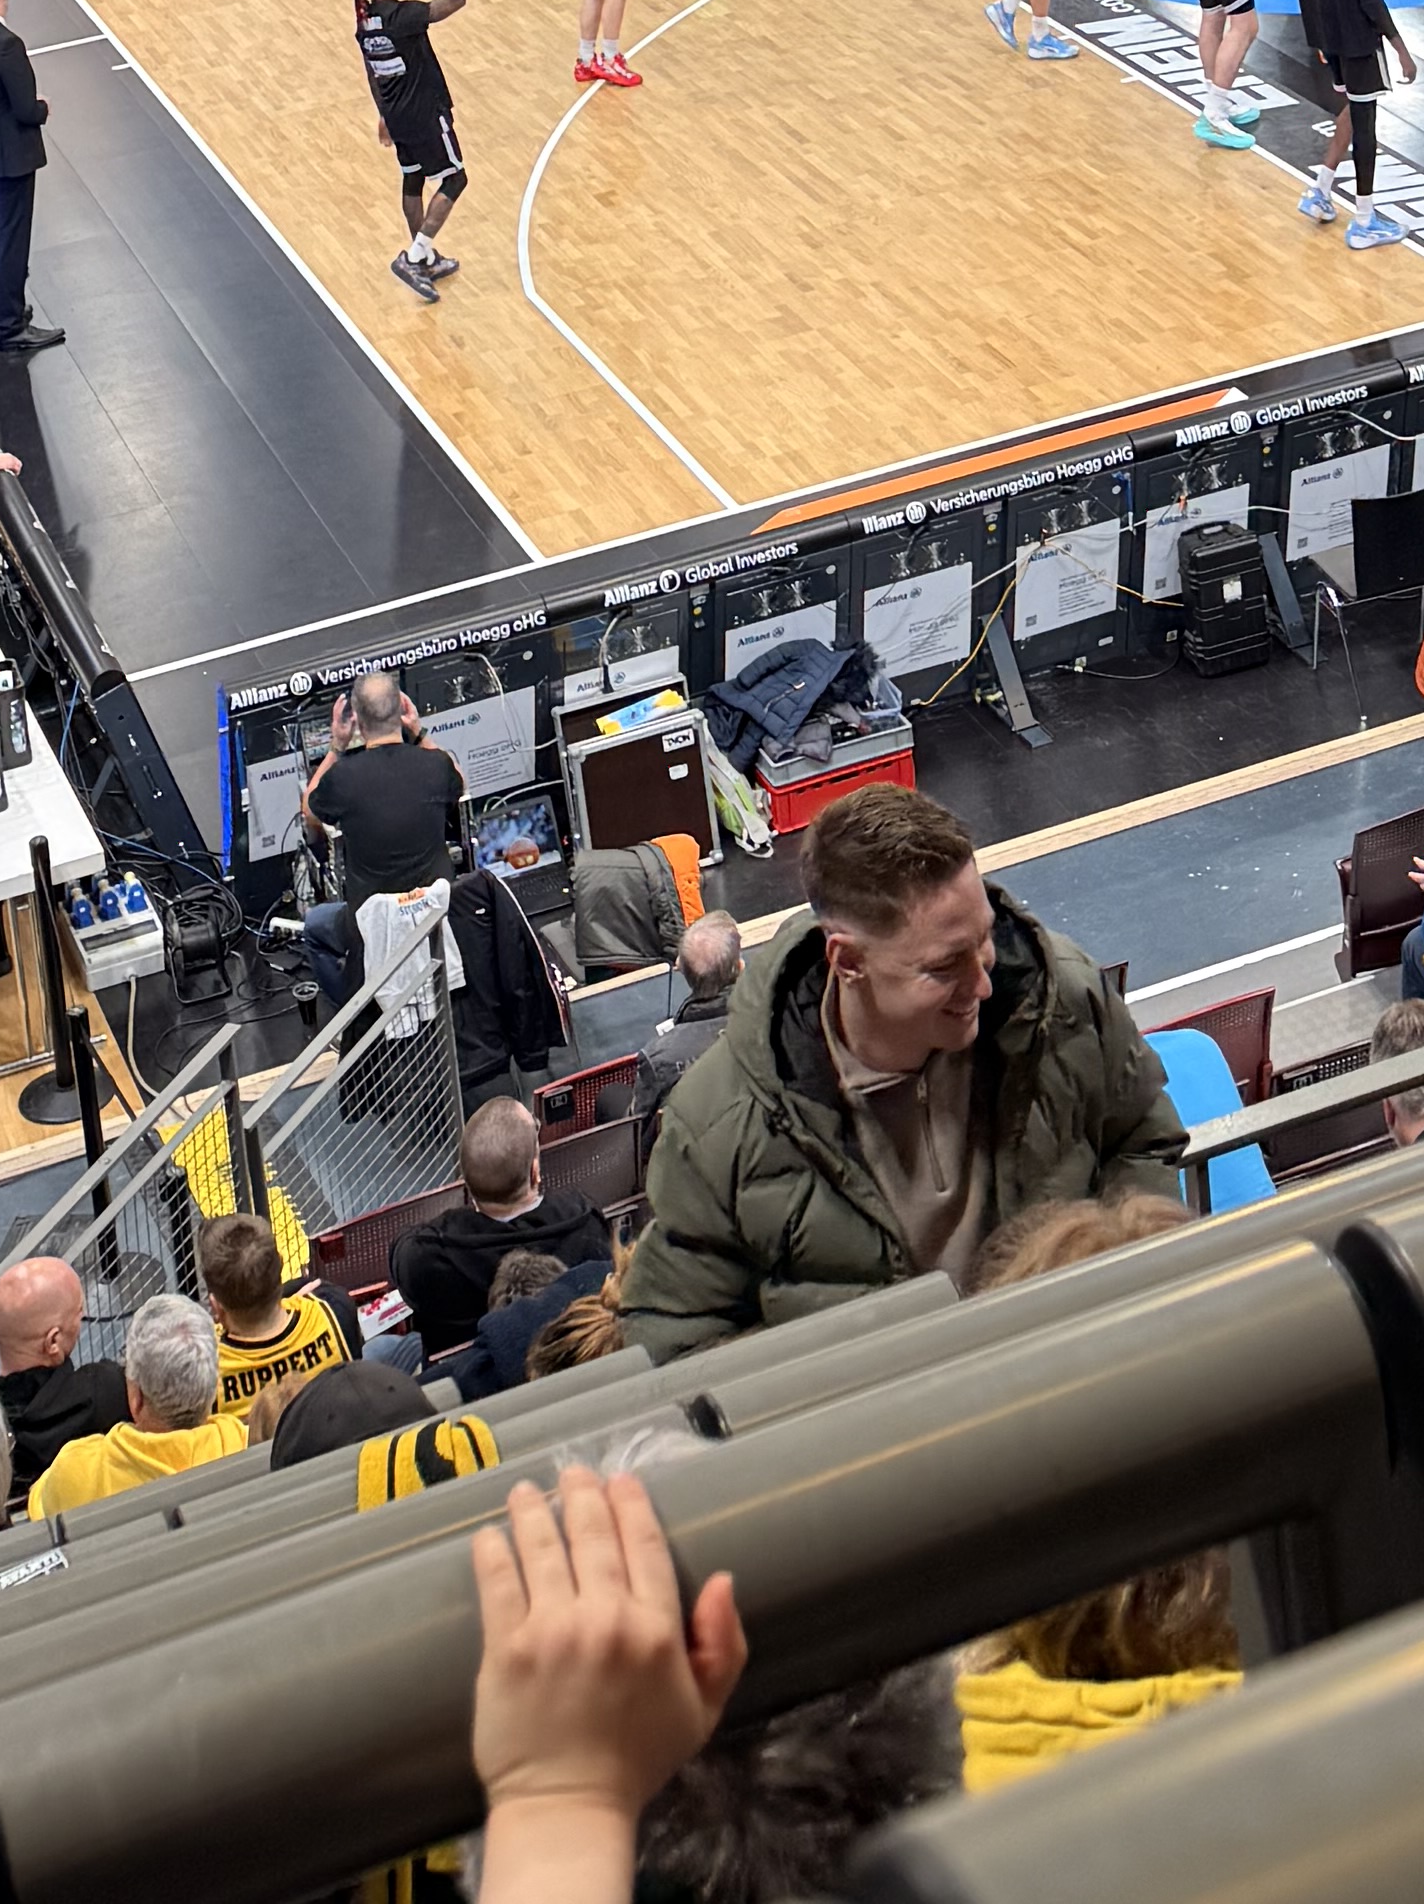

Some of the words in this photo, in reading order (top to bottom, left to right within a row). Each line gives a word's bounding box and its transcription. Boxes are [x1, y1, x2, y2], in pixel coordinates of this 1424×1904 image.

[1175, 420, 1230, 448] Allianz
[1255, 398, 1305, 426] Global
[1306, 383, 1369, 413] Investors
[929, 468, 1056, 515] Versicherungsbüro
[1056, 457, 1102, 481] Hoegg
[1103, 445, 1134, 467] oHG
[604, 578, 658, 608] Allianz
[685, 556, 732, 584] Global
[735, 541, 799, 570] Investors
[230, 681, 289, 711] Allianz
[317, 637, 458, 686] Versicherungsbüro
[459, 621, 511, 648] Hoegg
[513, 609, 547, 634] oHG
[429, 717, 466, 735] Allianz
[223, 1330, 335, 1404] RUPPERT
